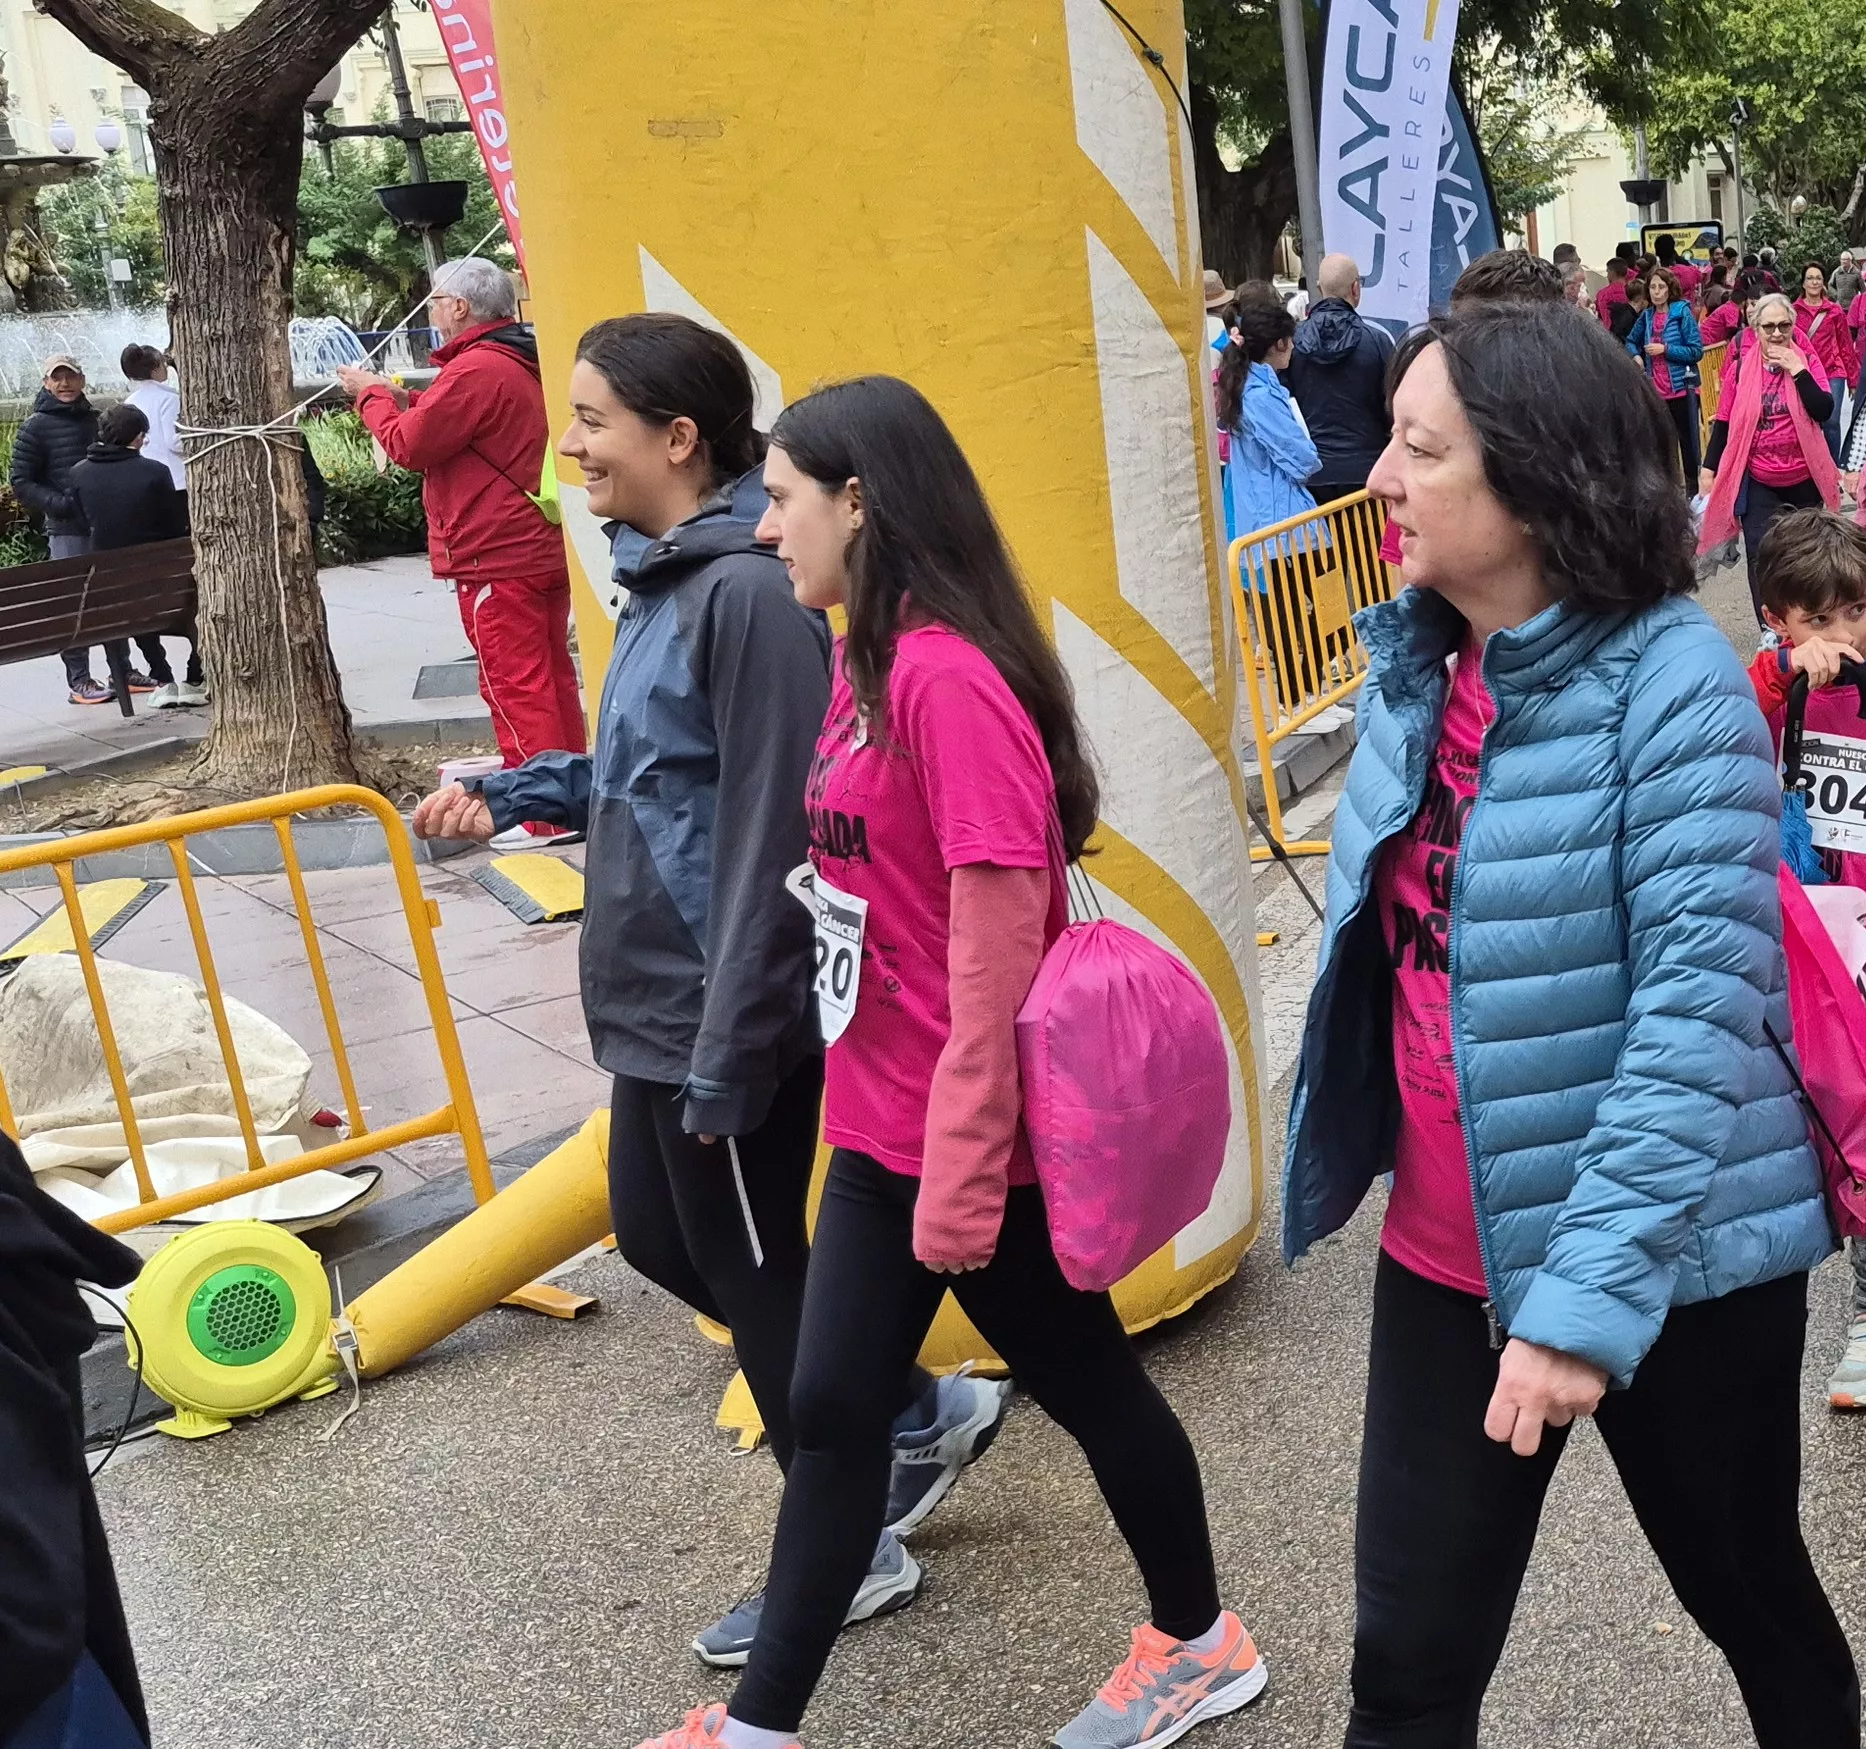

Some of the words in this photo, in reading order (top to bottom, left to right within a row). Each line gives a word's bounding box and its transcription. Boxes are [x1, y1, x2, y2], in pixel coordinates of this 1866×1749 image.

[1397, 55, 1431, 292] TALLERES
[1848, 759, 1862, 772] EL
[820, 913, 860, 942] CÁNCER
